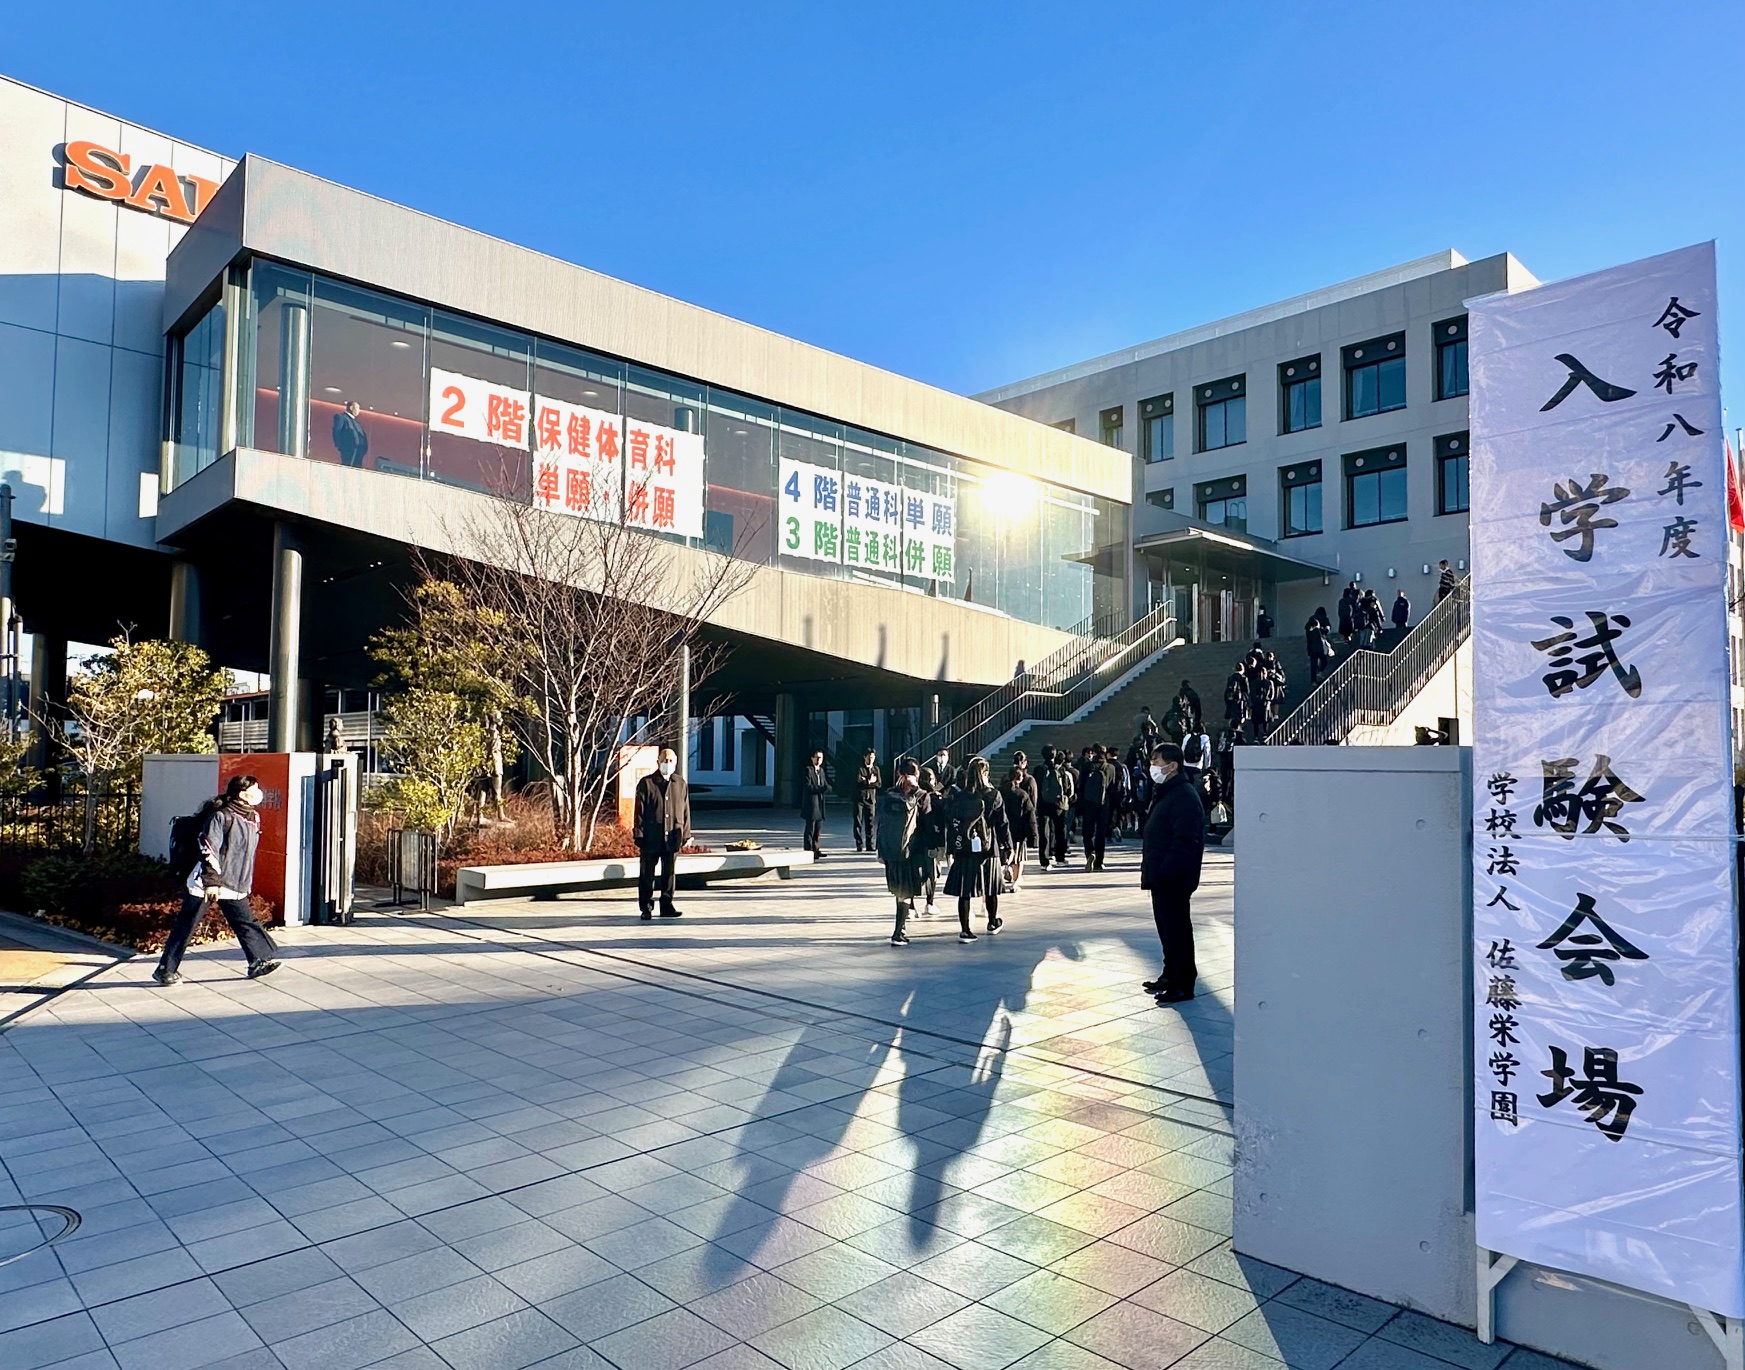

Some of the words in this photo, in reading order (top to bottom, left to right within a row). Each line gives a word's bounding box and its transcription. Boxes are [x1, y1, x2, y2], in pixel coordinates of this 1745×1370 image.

[1652, 297, 1704, 558] 令和八年度
[1485, 772, 1522, 911] 学校法人
[1531, 354, 1649, 1142] 入学試験会場
[1485, 938, 1523, 1127] 佐藤栄学園
